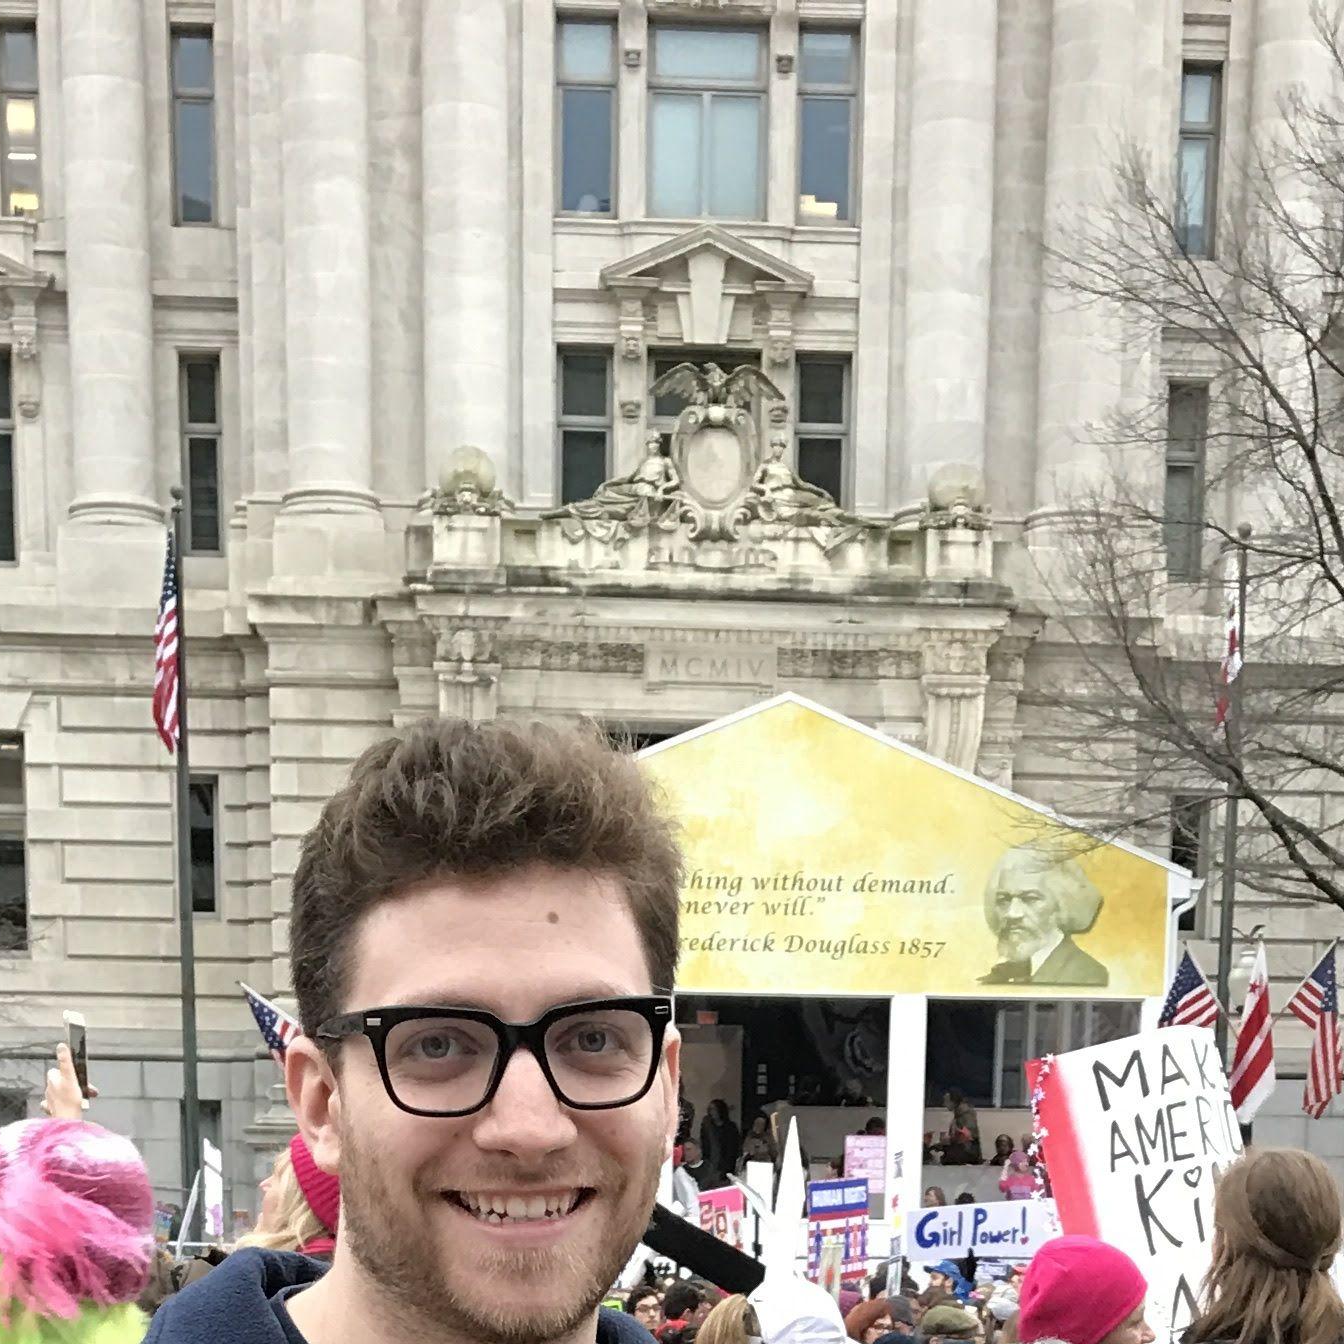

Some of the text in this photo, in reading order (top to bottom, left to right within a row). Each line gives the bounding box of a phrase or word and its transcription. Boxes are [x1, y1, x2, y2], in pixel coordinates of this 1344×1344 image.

[660, 656, 765, 678] MCMIV
[752, 870, 843, 893] without
[853, 871, 956, 895] demand.
[685, 900, 755, 915] never
[784, 932, 891, 960] Douglass
[899, 937, 946, 959] 1857
[915, 1211, 963, 1249] Girl
[971, 1206, 1030, 1247] Power!
